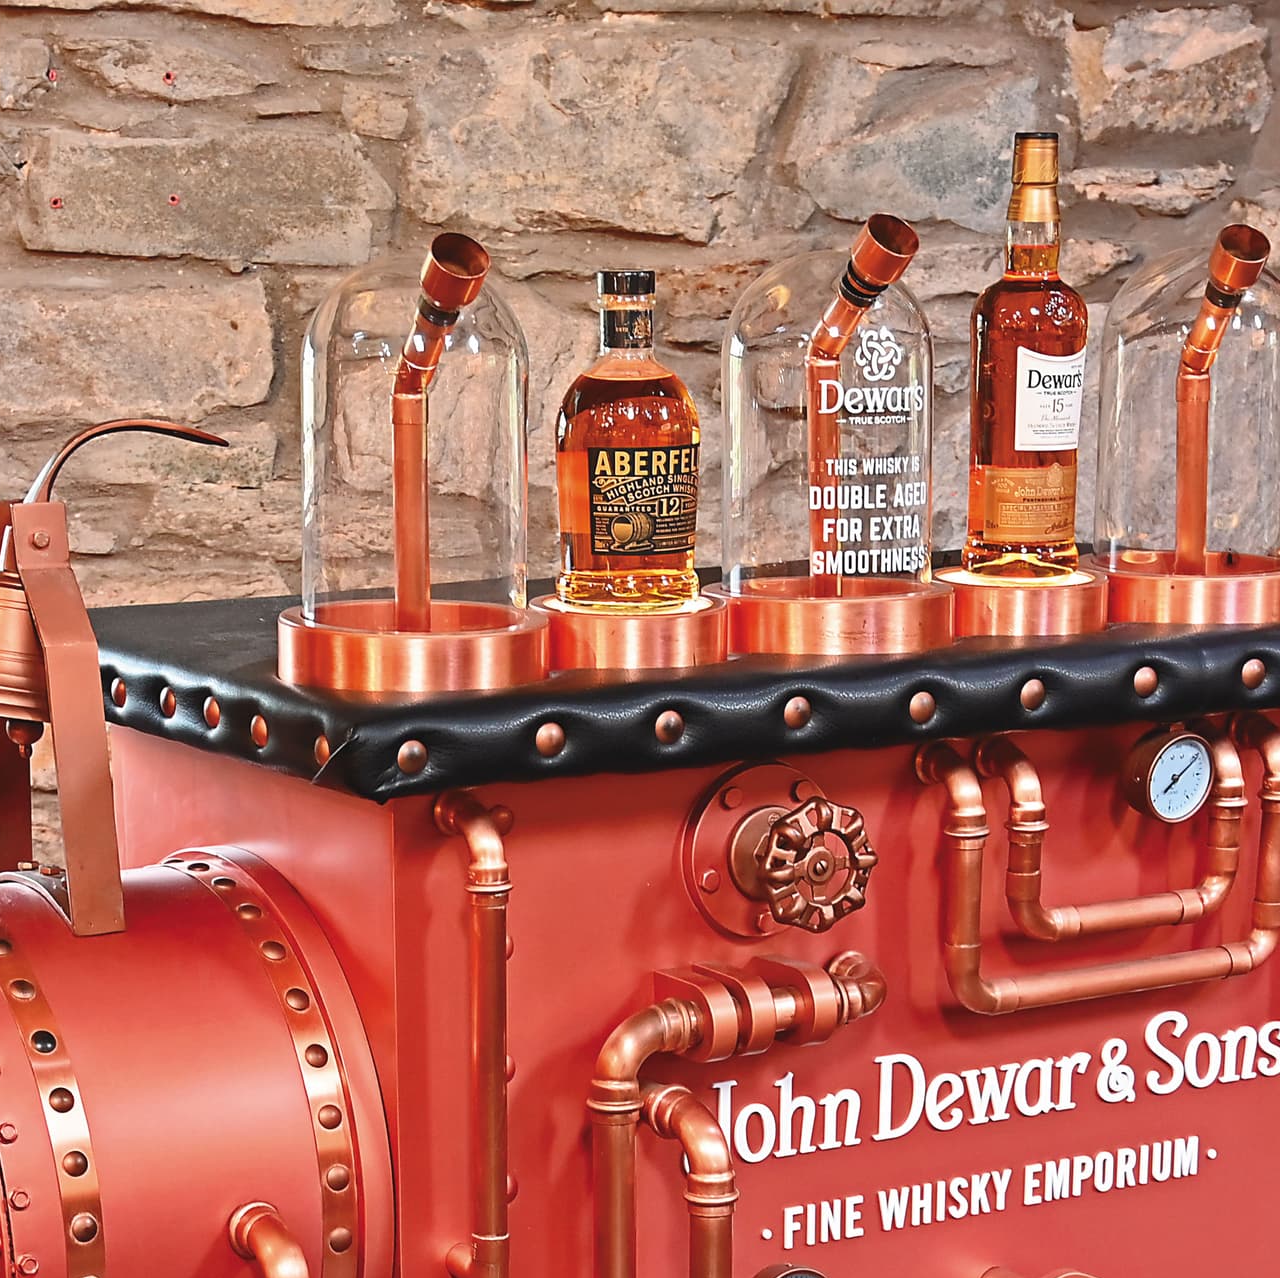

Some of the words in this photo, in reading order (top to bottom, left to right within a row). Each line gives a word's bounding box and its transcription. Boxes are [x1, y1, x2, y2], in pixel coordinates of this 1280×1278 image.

[1027, 369, 1082, 389] Dewar's
[1052, 398, 1064, 413] 15
[849, 416, 873, 425] TRUE
[875, 415, 906, 425] SCOTCH
[825, 458, 857, 476] THIS
[863, 456, 909, 475] WHISKY
[911, 455, 920, 472] IS
[606, 476, 664, 500] HIGHLAND
[668, 474, 694, 485] SINGLE
[627, 484, 670, 502] SCOTCH
[809, 484, 887, 510] DOUBLE
[893, 481, 926, 508] AGED
[597, 505, 652, 513] GUARANTEED
[660, 497, 680, 517] 12
[823, 517, 862, 542] FOR
[870, 514, 920, 541] EXTRA
[812, 546, 926, 575] SMOOTHNESS
[685, 1071, 862, 1168] John
[872, 1053, 1091, 1141] Dewar
[1096, 1037, 1136, 1103] &
[783, 1194, 864, 1250] FINE
[878, 1168, 1012, 1232] WHISKY
[1024, 1135, 1199, 1206] EMPORIUM
